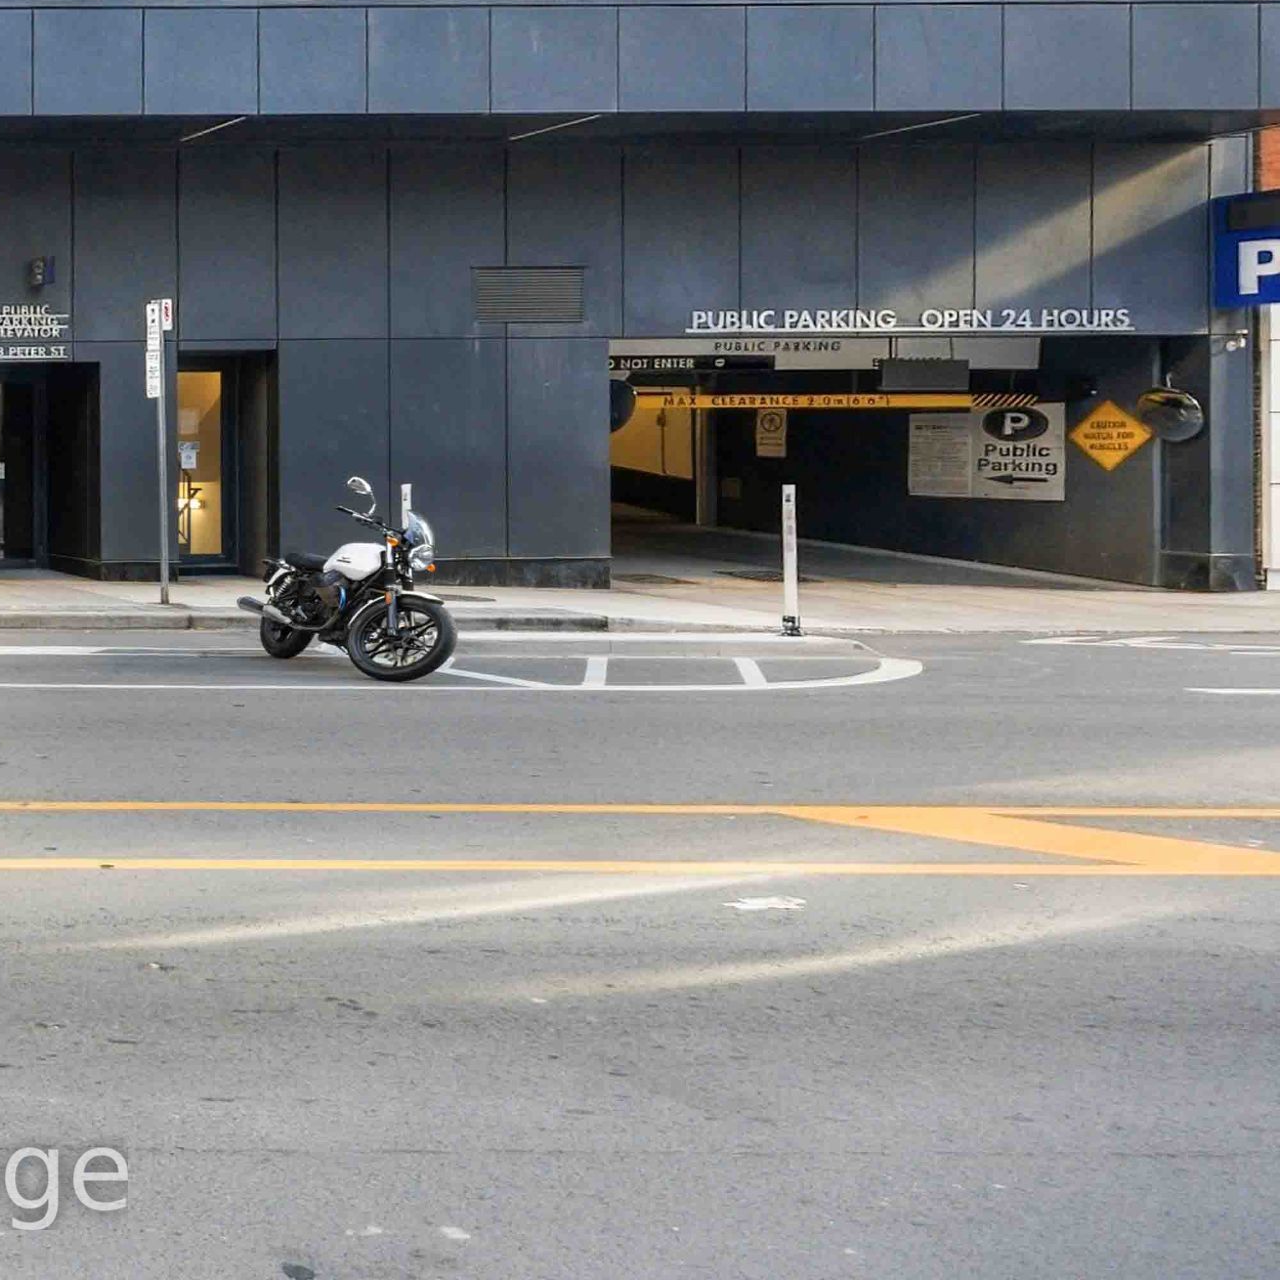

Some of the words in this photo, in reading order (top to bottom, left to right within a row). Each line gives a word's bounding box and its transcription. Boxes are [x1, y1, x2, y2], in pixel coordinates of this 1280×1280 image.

[2, 305, 51, 316] PUBLIC
[692, 310, 776, 329] PUBLIC
[784, 310, 898, 329] PARKING
[920, 309, 992, 328] OPEN
[1000, 309, 1033, 328] 24
[1040, 308, 1131, 328] HOURS
[9, 345, 47, 358] PETER
[50, 345, 66, 358] ST
[714, 341, 765, 352] PUBLIC
[773, 341, 841, 352] PARKING
[620, 358, 648, 369] NOT
[653, 358, 695, 369] ENTER
[663, 396, 697, 406] MAX
[711, 396, 799, 406] CLEARANCE
[1003, 412, 1030, 435] P
[984, 443, 1051, 458] Public
[977, 458, 1058, 476] Parking
